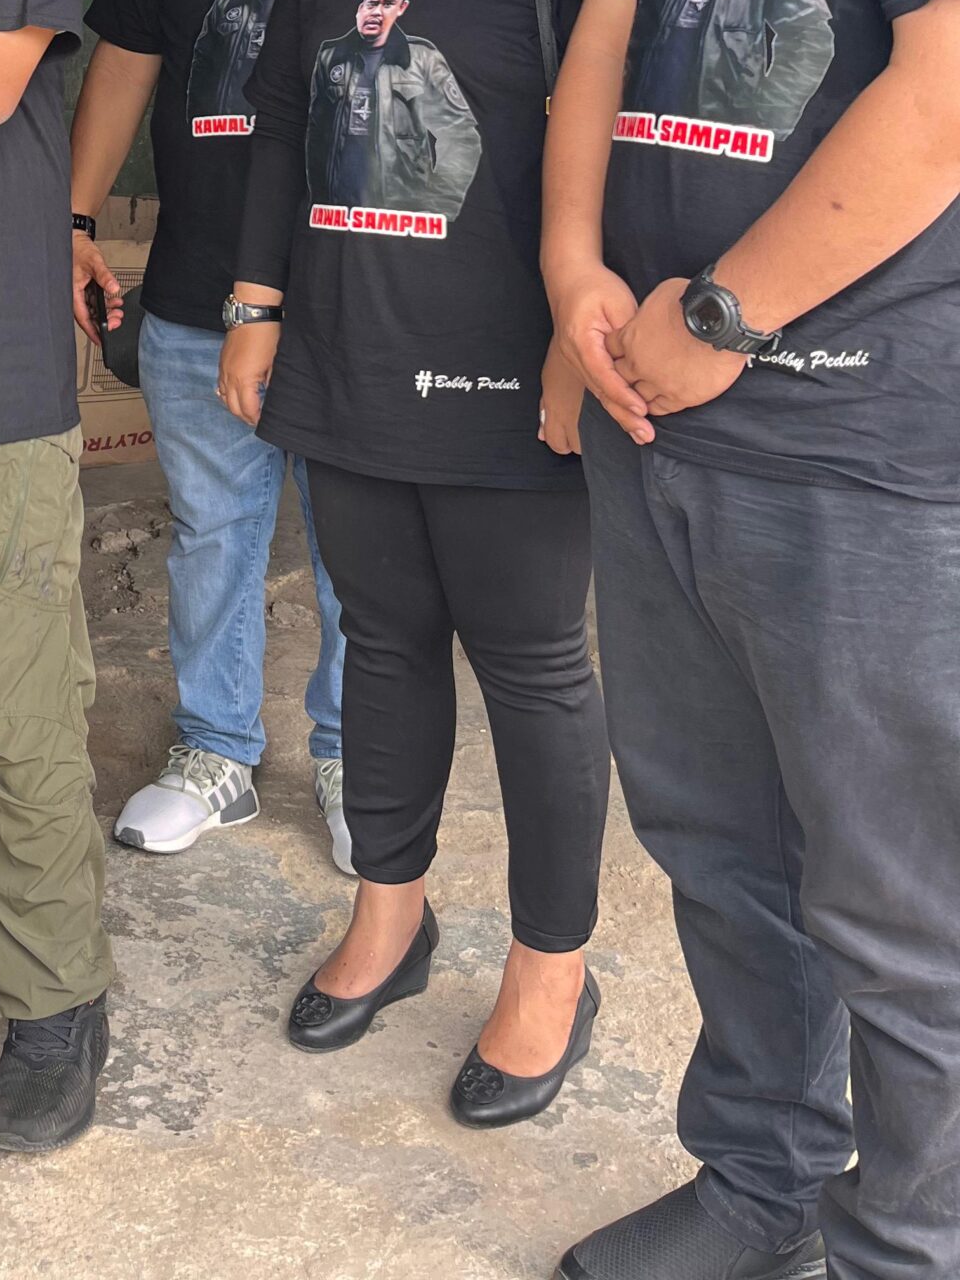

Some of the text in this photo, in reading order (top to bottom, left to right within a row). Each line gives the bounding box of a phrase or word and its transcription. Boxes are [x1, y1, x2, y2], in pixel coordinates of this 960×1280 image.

[194, 118, 249, 134] KAWAL
[659, 119, 769, 158] SAMPAH
[311, 207, 443, 235] KAWAL SAMPAH
[810, 349, 870, 370] Peduli
[82, 430, 155, 452] OLYTR
